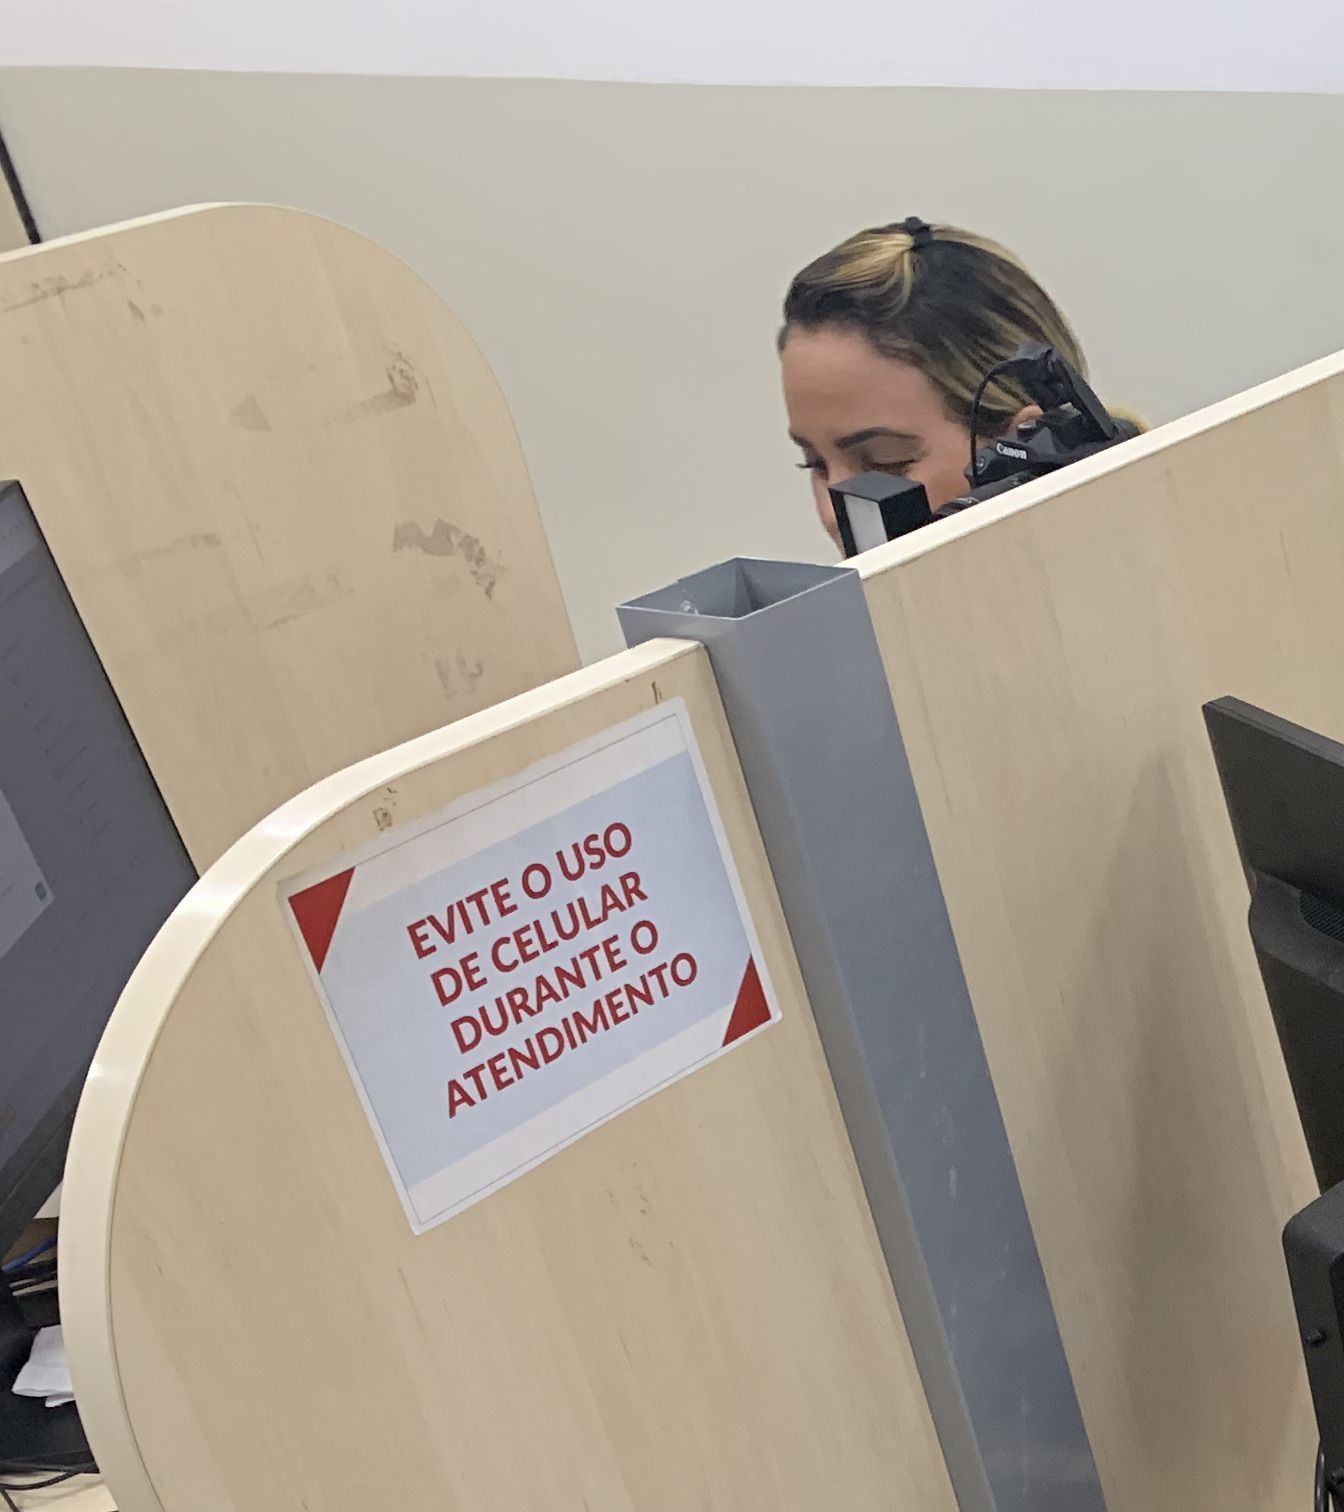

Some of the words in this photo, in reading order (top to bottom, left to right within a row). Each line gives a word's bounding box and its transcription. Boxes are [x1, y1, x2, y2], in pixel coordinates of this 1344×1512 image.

[996, 442, 1028, 460] Canon
[406, 878, 518, 959] EVITE
[521, 863, 552, 900] O
[555, 822, 633, 882] USO
[431, 957, 486, 1006] DE
[491, 871, 649, 973] CELULAR
[448, 952, 698, 1119] ATENDIMENTO
[450, 934, 627, 1054] DURANTE
[630, 919, 659, 955] O
